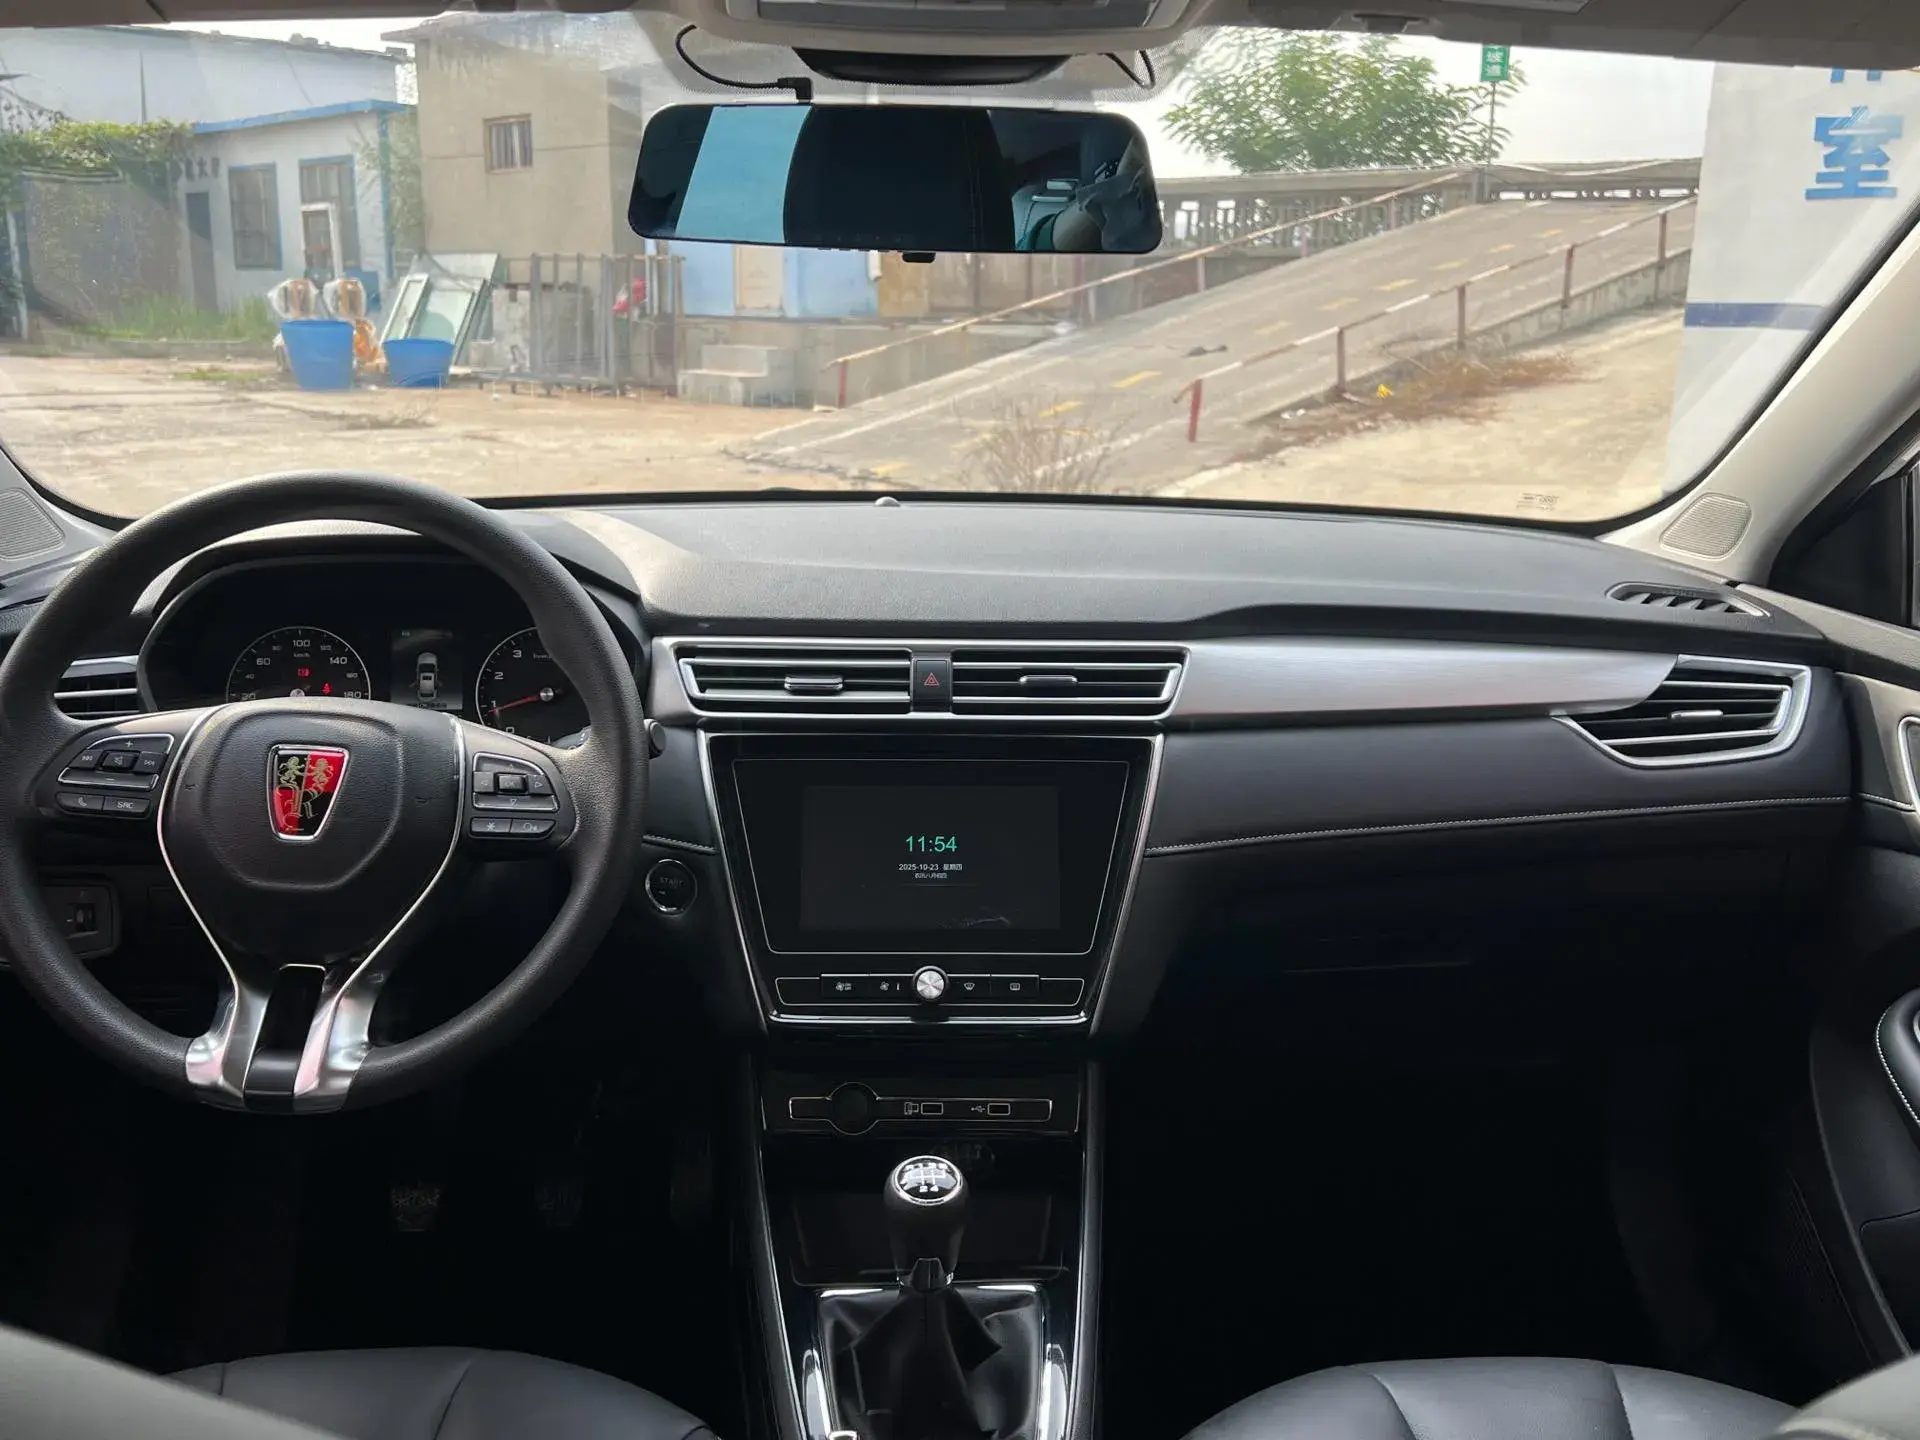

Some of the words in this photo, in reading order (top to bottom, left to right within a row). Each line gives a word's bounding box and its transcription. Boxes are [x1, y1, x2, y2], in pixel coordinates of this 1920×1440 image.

[1806, 67, 1904, 200] 室
[513, 650, 522, 658] 3
[256, 658, 271, 666] 60
[329, 657, 348, 665] 140
[494, 672, 504, 680] 2
[905, 835, 958, 852] 11:54
[898, 863, 939, 871] 2025-10-23
